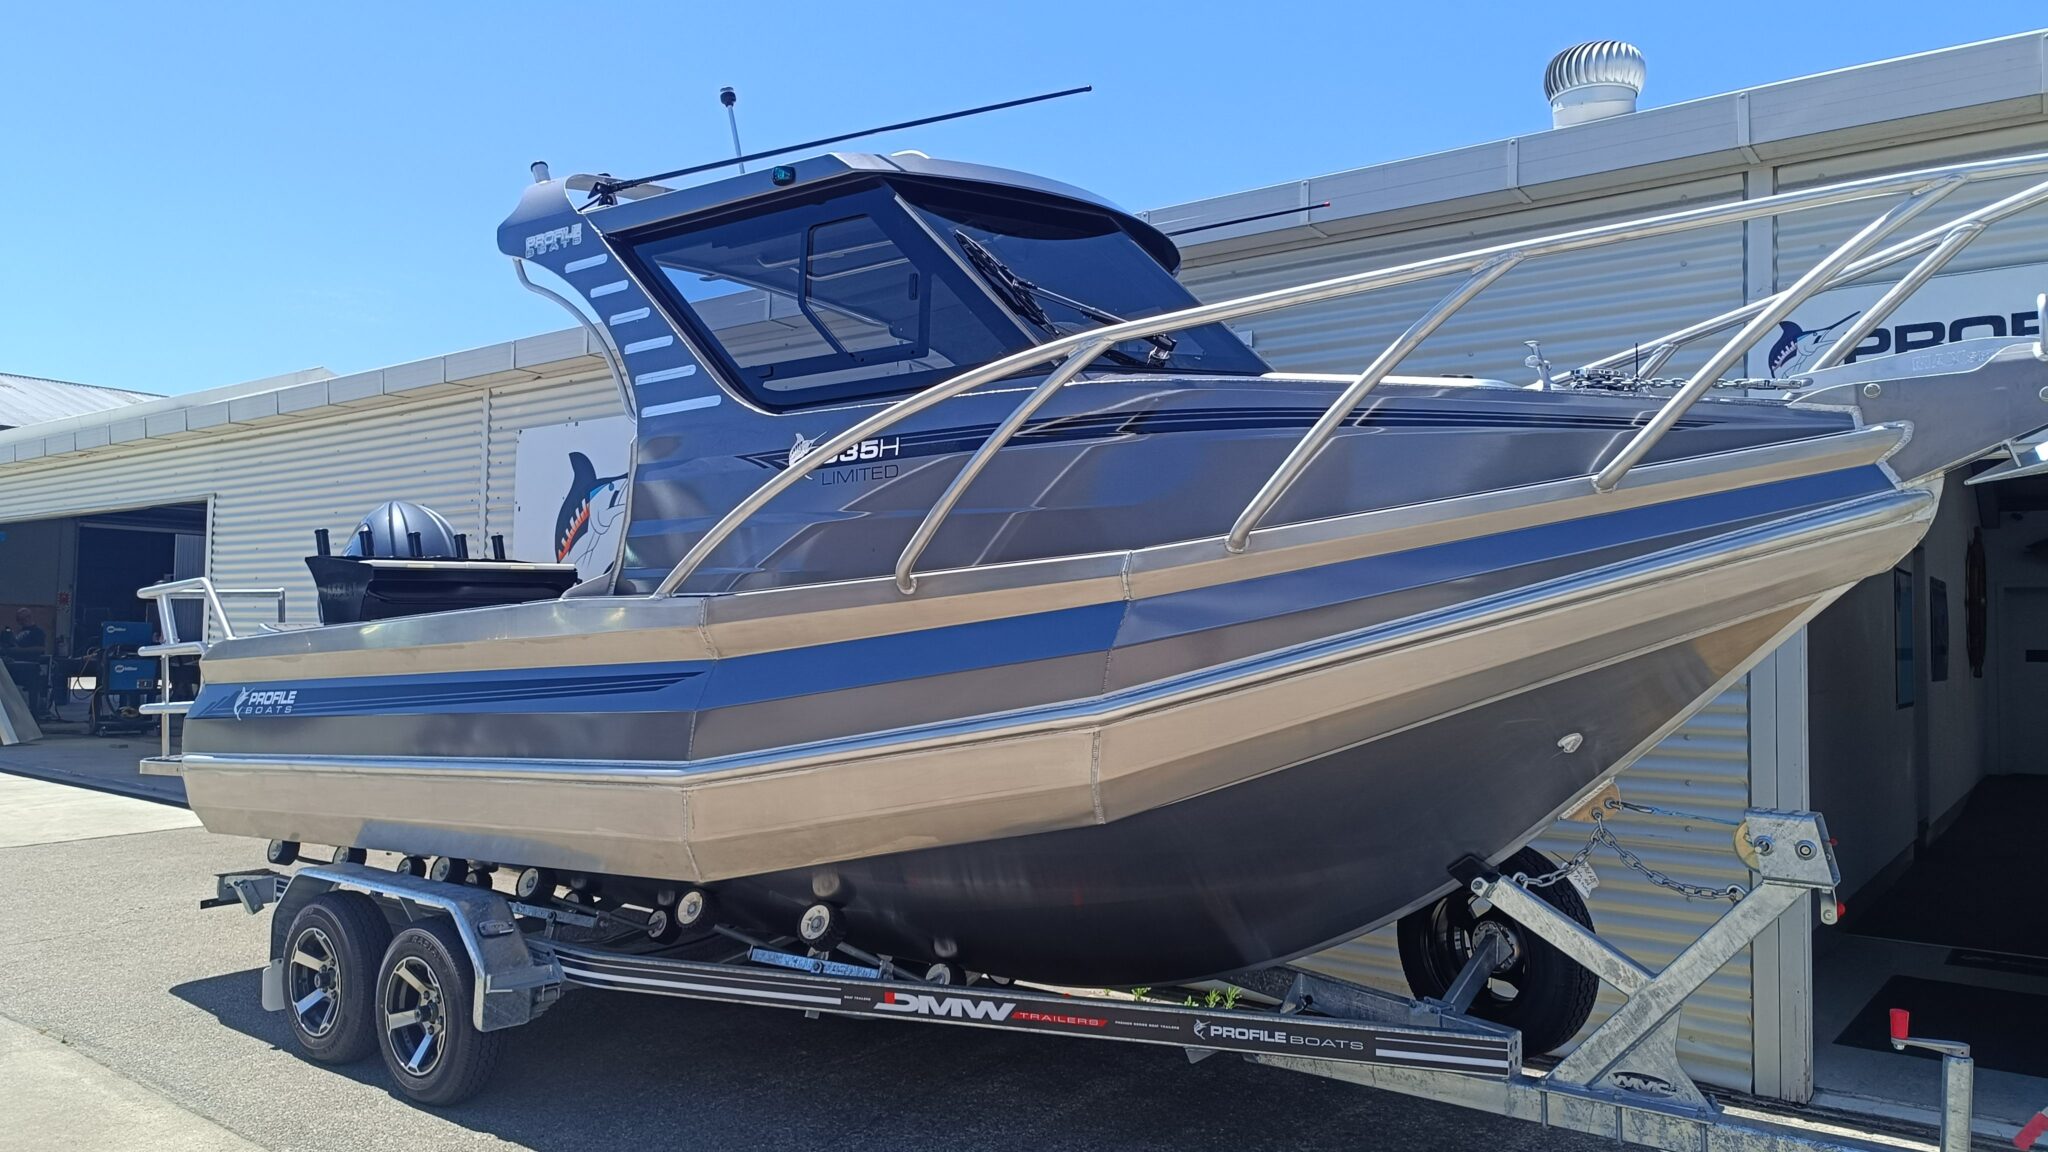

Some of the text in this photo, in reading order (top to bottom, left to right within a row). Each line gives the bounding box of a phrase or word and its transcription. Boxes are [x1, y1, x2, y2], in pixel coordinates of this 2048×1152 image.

[526, 223, 582, 250] PROFILE
[526, 237, 582, 259] BOATS
[823, 437, 900, 464] 35H
[822, 464, 899, 486] LIMITED
[248, 690, 298, 706] PROFILE
[245, 705, 293, 715] BOATS
[873, 991, 1099, 1026] DMW TRAILERS
[1210, 1025, 1364, 1050] PROFILE BOATS
